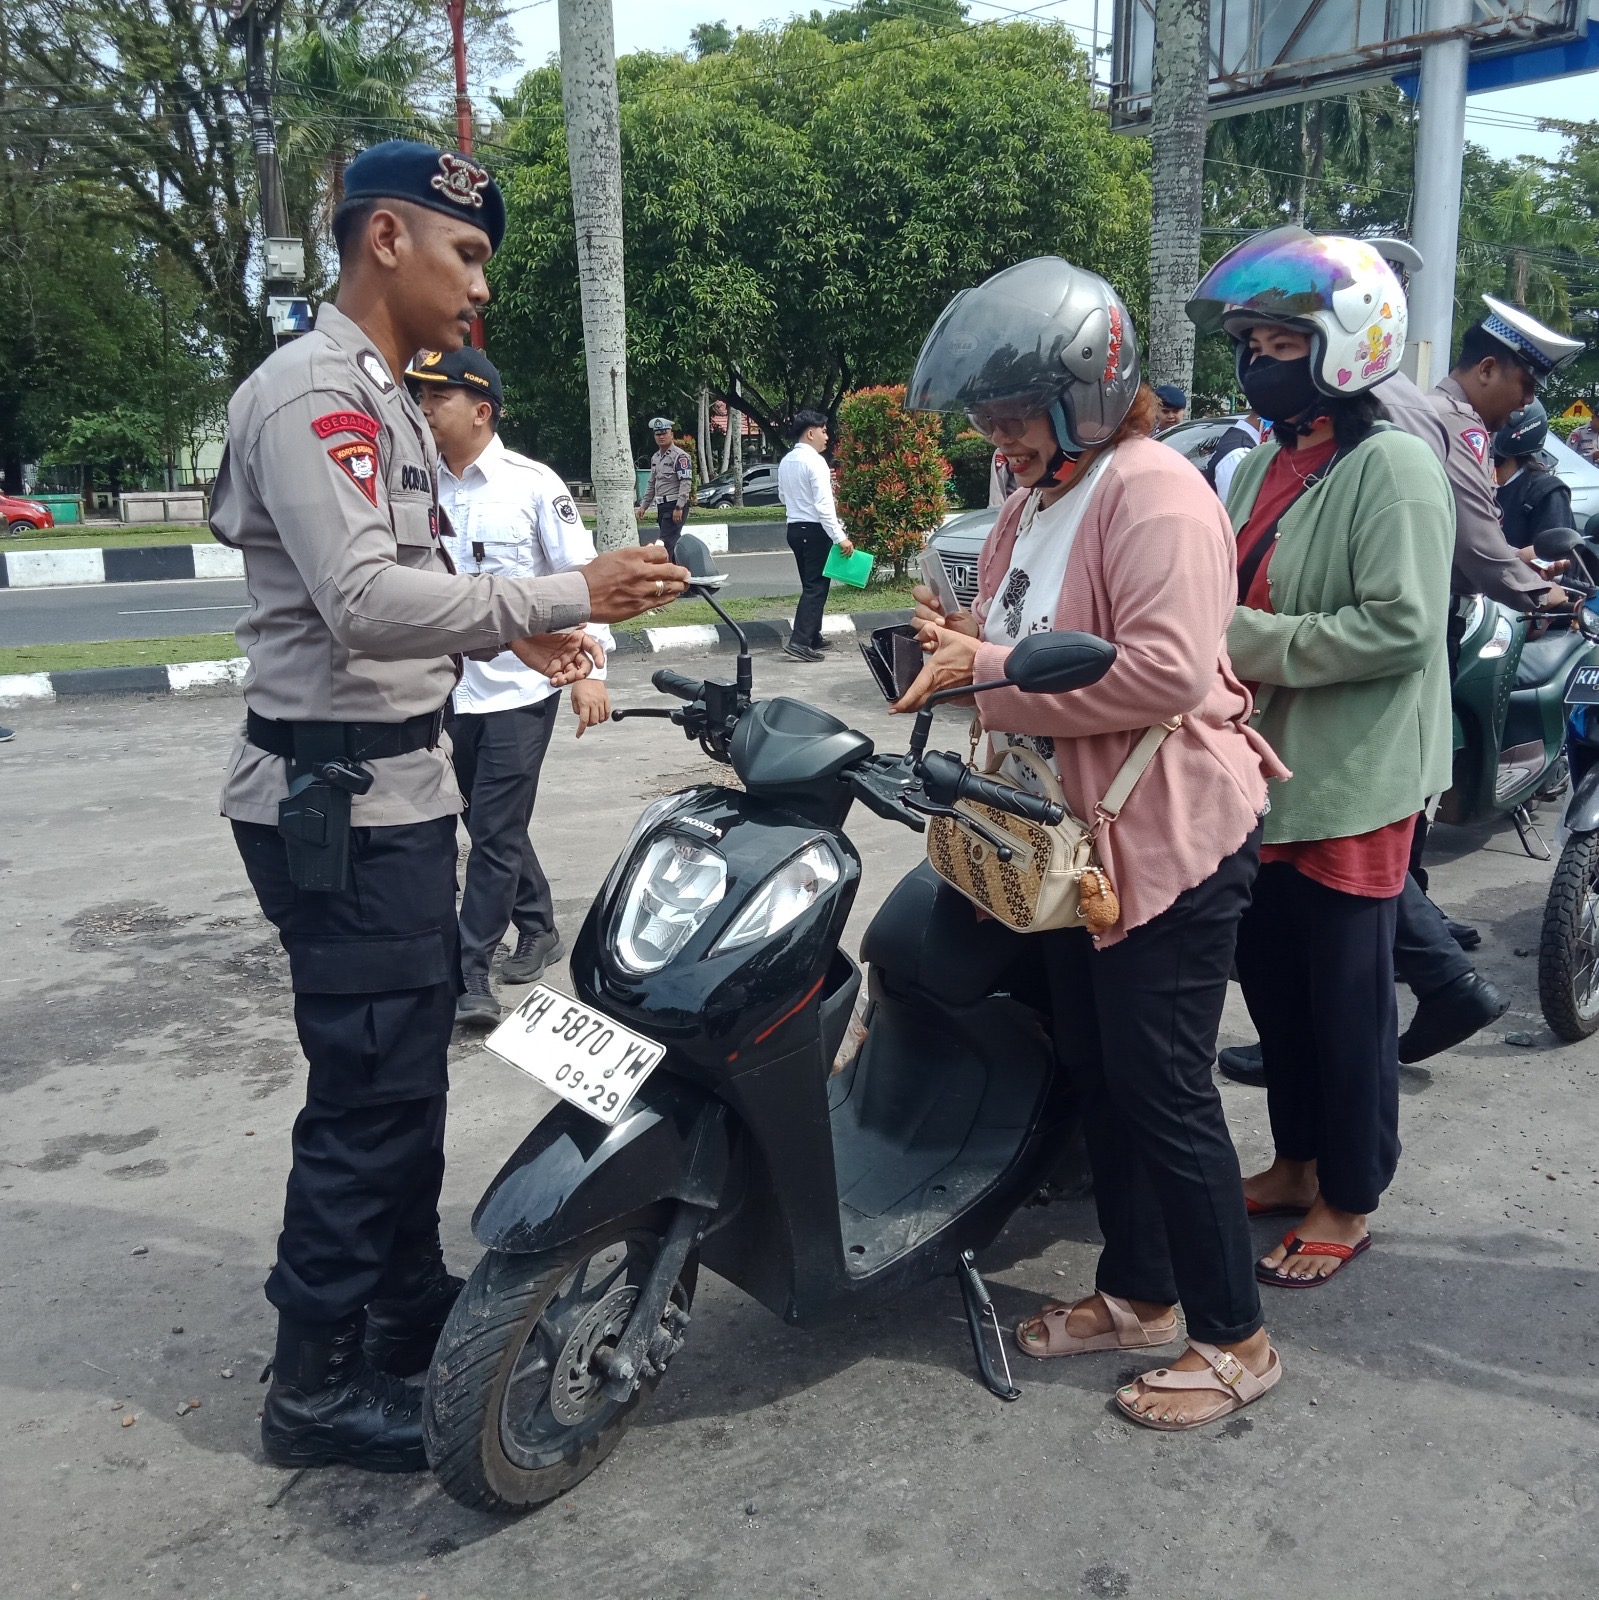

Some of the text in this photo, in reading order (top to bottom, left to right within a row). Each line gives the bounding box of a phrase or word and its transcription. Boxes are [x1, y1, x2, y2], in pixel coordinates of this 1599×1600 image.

[463, 372, 489, 387] KORPRI
[321, 415, 373, 431] GEGANA
[337, 446, 357, 458] KORPS
[1576, 670, 1599, 684] KH
[680, 816, 722, 837] HONDA
[515, 989, 656, 1080] KH 5870 YW
